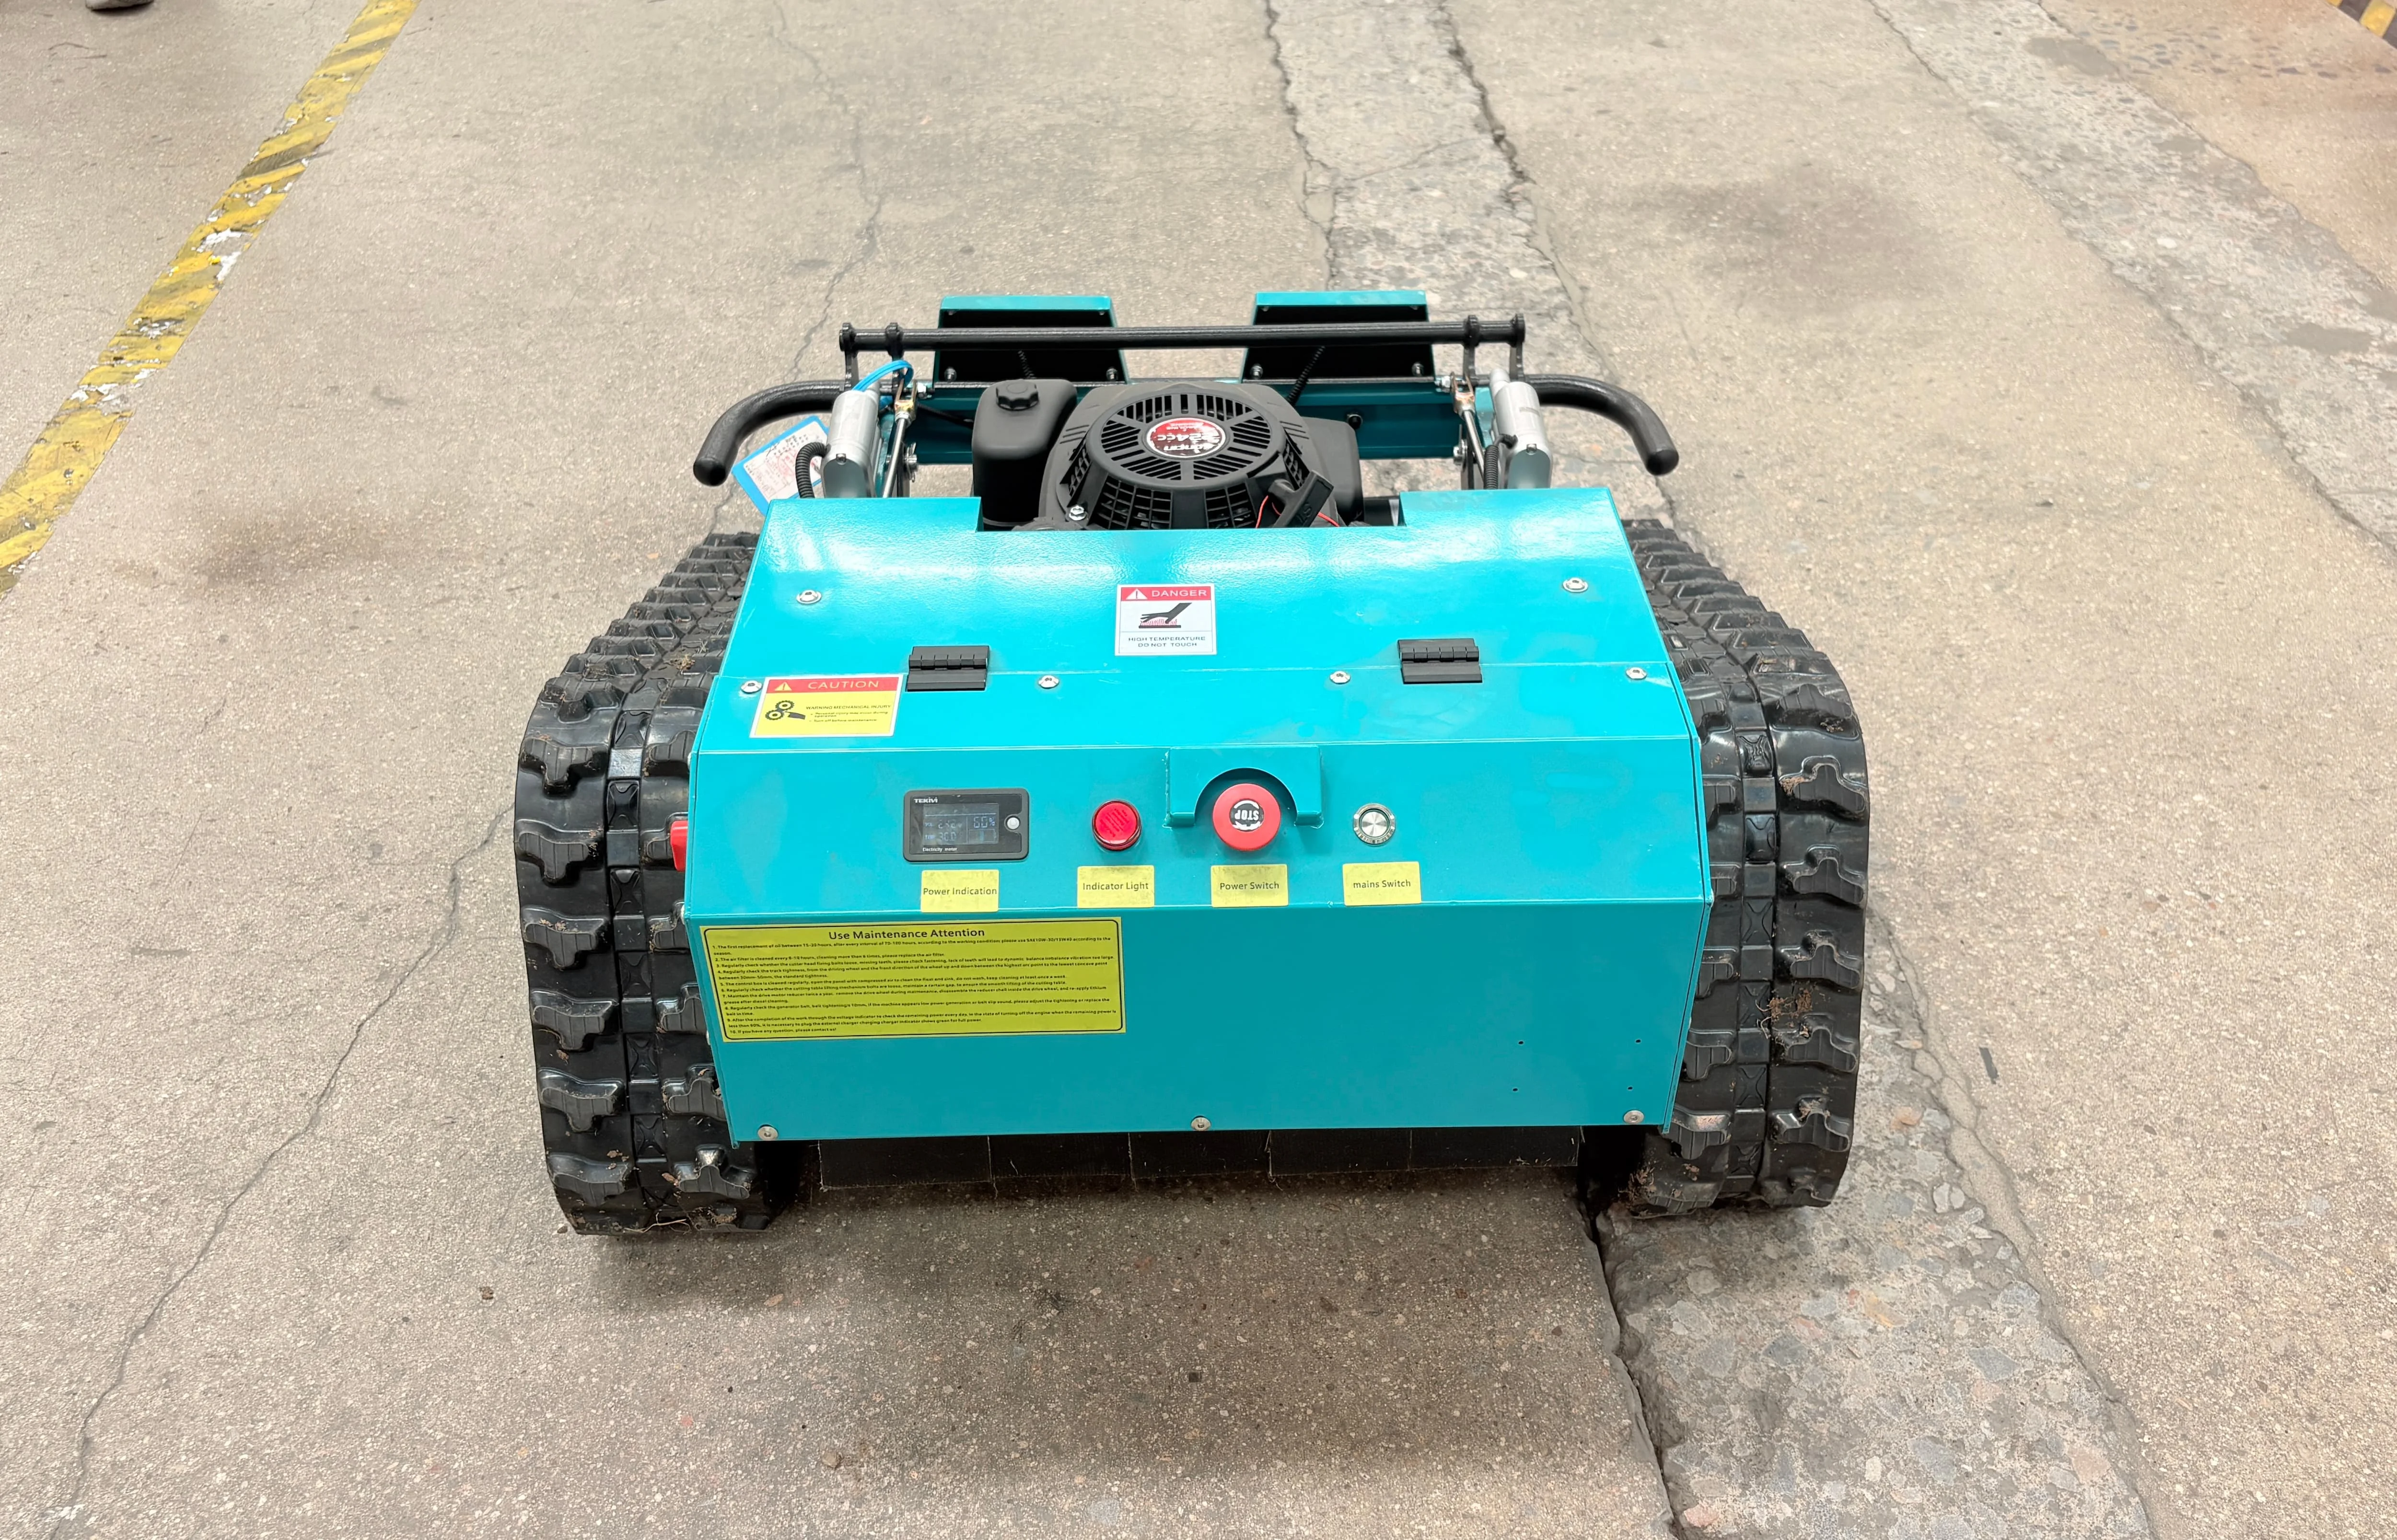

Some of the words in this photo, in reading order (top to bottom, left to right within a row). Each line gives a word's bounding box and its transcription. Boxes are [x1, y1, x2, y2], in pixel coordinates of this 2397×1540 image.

[808, 681, 879, 689] CAUTION
[1234, 810, 1259, 821] STOP
[1083, 882, 1124, 890] Indicator
[1126, 881, 1149, 892] Light
[1250, 881, 1279, 890] Switch
[1382, 879, 1411, 888] Switch
[953, 887, 997, 895] Indication
[828, 931, 850, 940] Use
[853, 930, 927, 939] Maintenance
[930, 928, 985, 938] Attention
